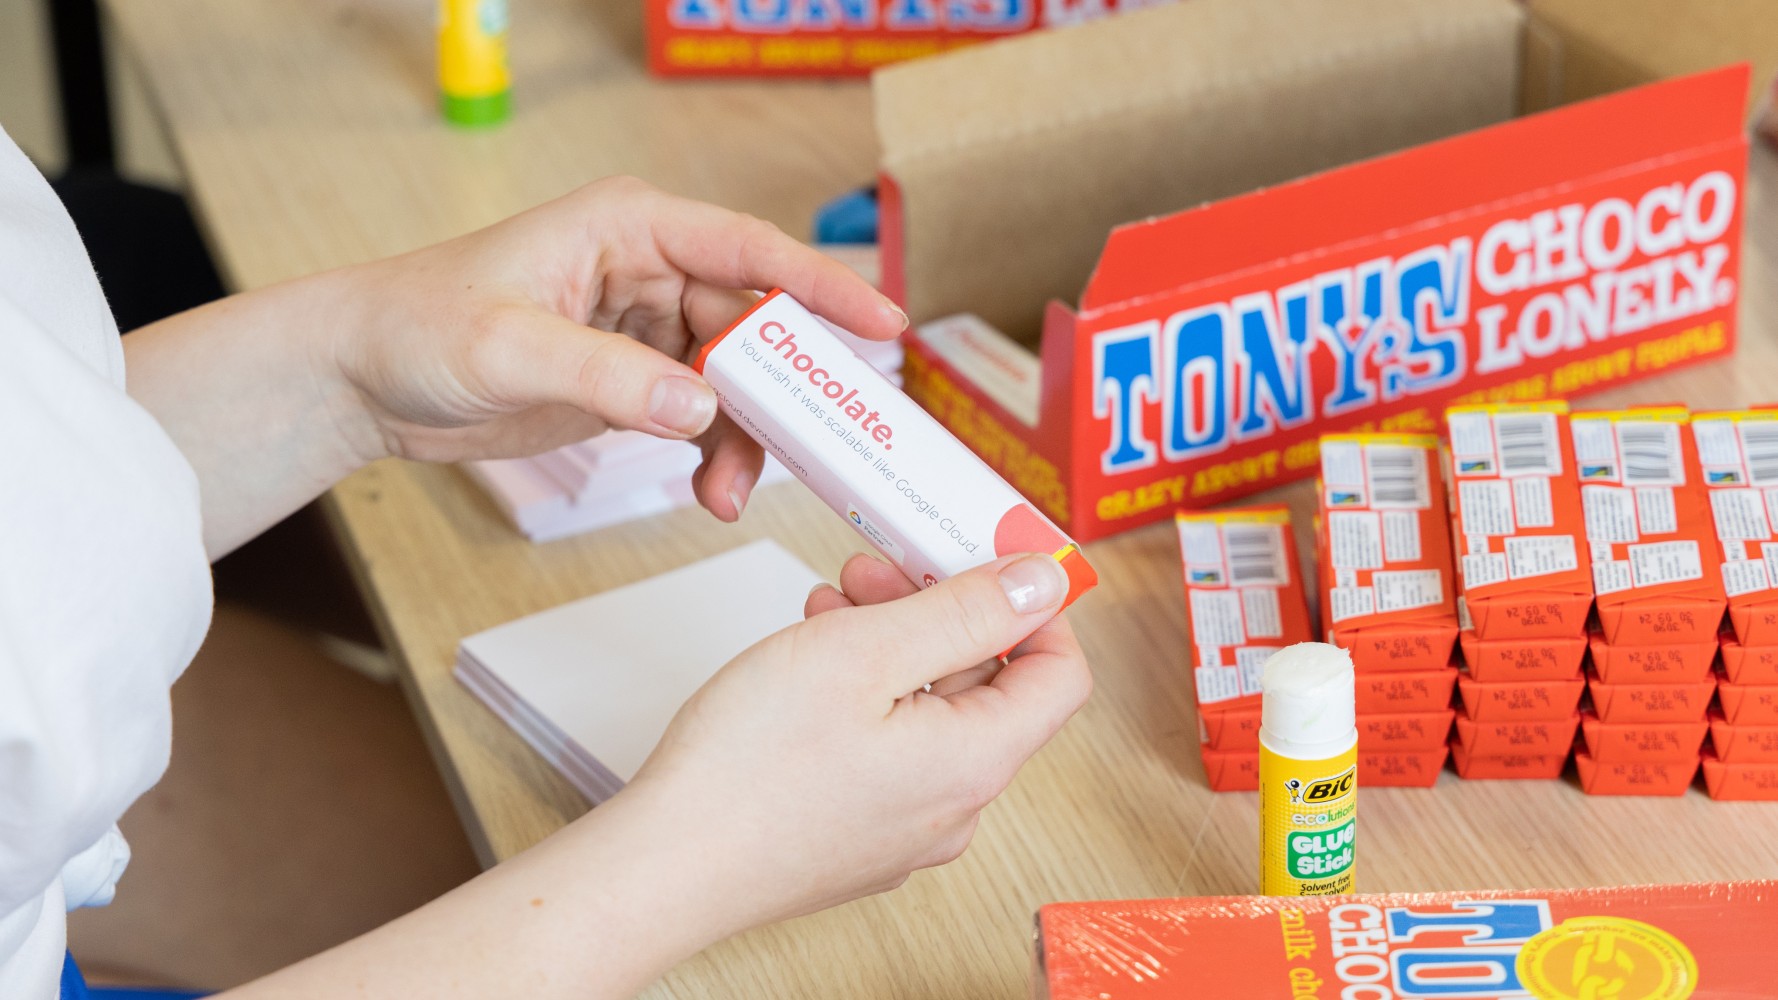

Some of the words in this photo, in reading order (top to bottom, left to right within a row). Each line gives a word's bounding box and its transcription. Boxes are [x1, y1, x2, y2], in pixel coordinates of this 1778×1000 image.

[1476, 170, 1737, 296] CHOCO
[1092, 236, 1472, 476] TONY'S
[758, 320, 894, 451] Chocolate.
[740, 338, 762, 367] You
[762, 357, 791, 389] wish
[791, 379, 802, 398] it
[801, 395, 825, 420] was
[824, 413, 874, 462] scalable
[872, 457, 896, 482] like
[895, 477, 941, 523] Google
[939, 517, 977, 557] Cloud.
[1291, 802, 1355, 826] ecolutions
[1296, 847, 1352, 875] Stick
[1301, 881, 1336, 893] Solvent
[1338, 874, 1350, 886] free
[1323, 881, 1351, 896] solvant
[1279, 907, 1317, 961] milk
